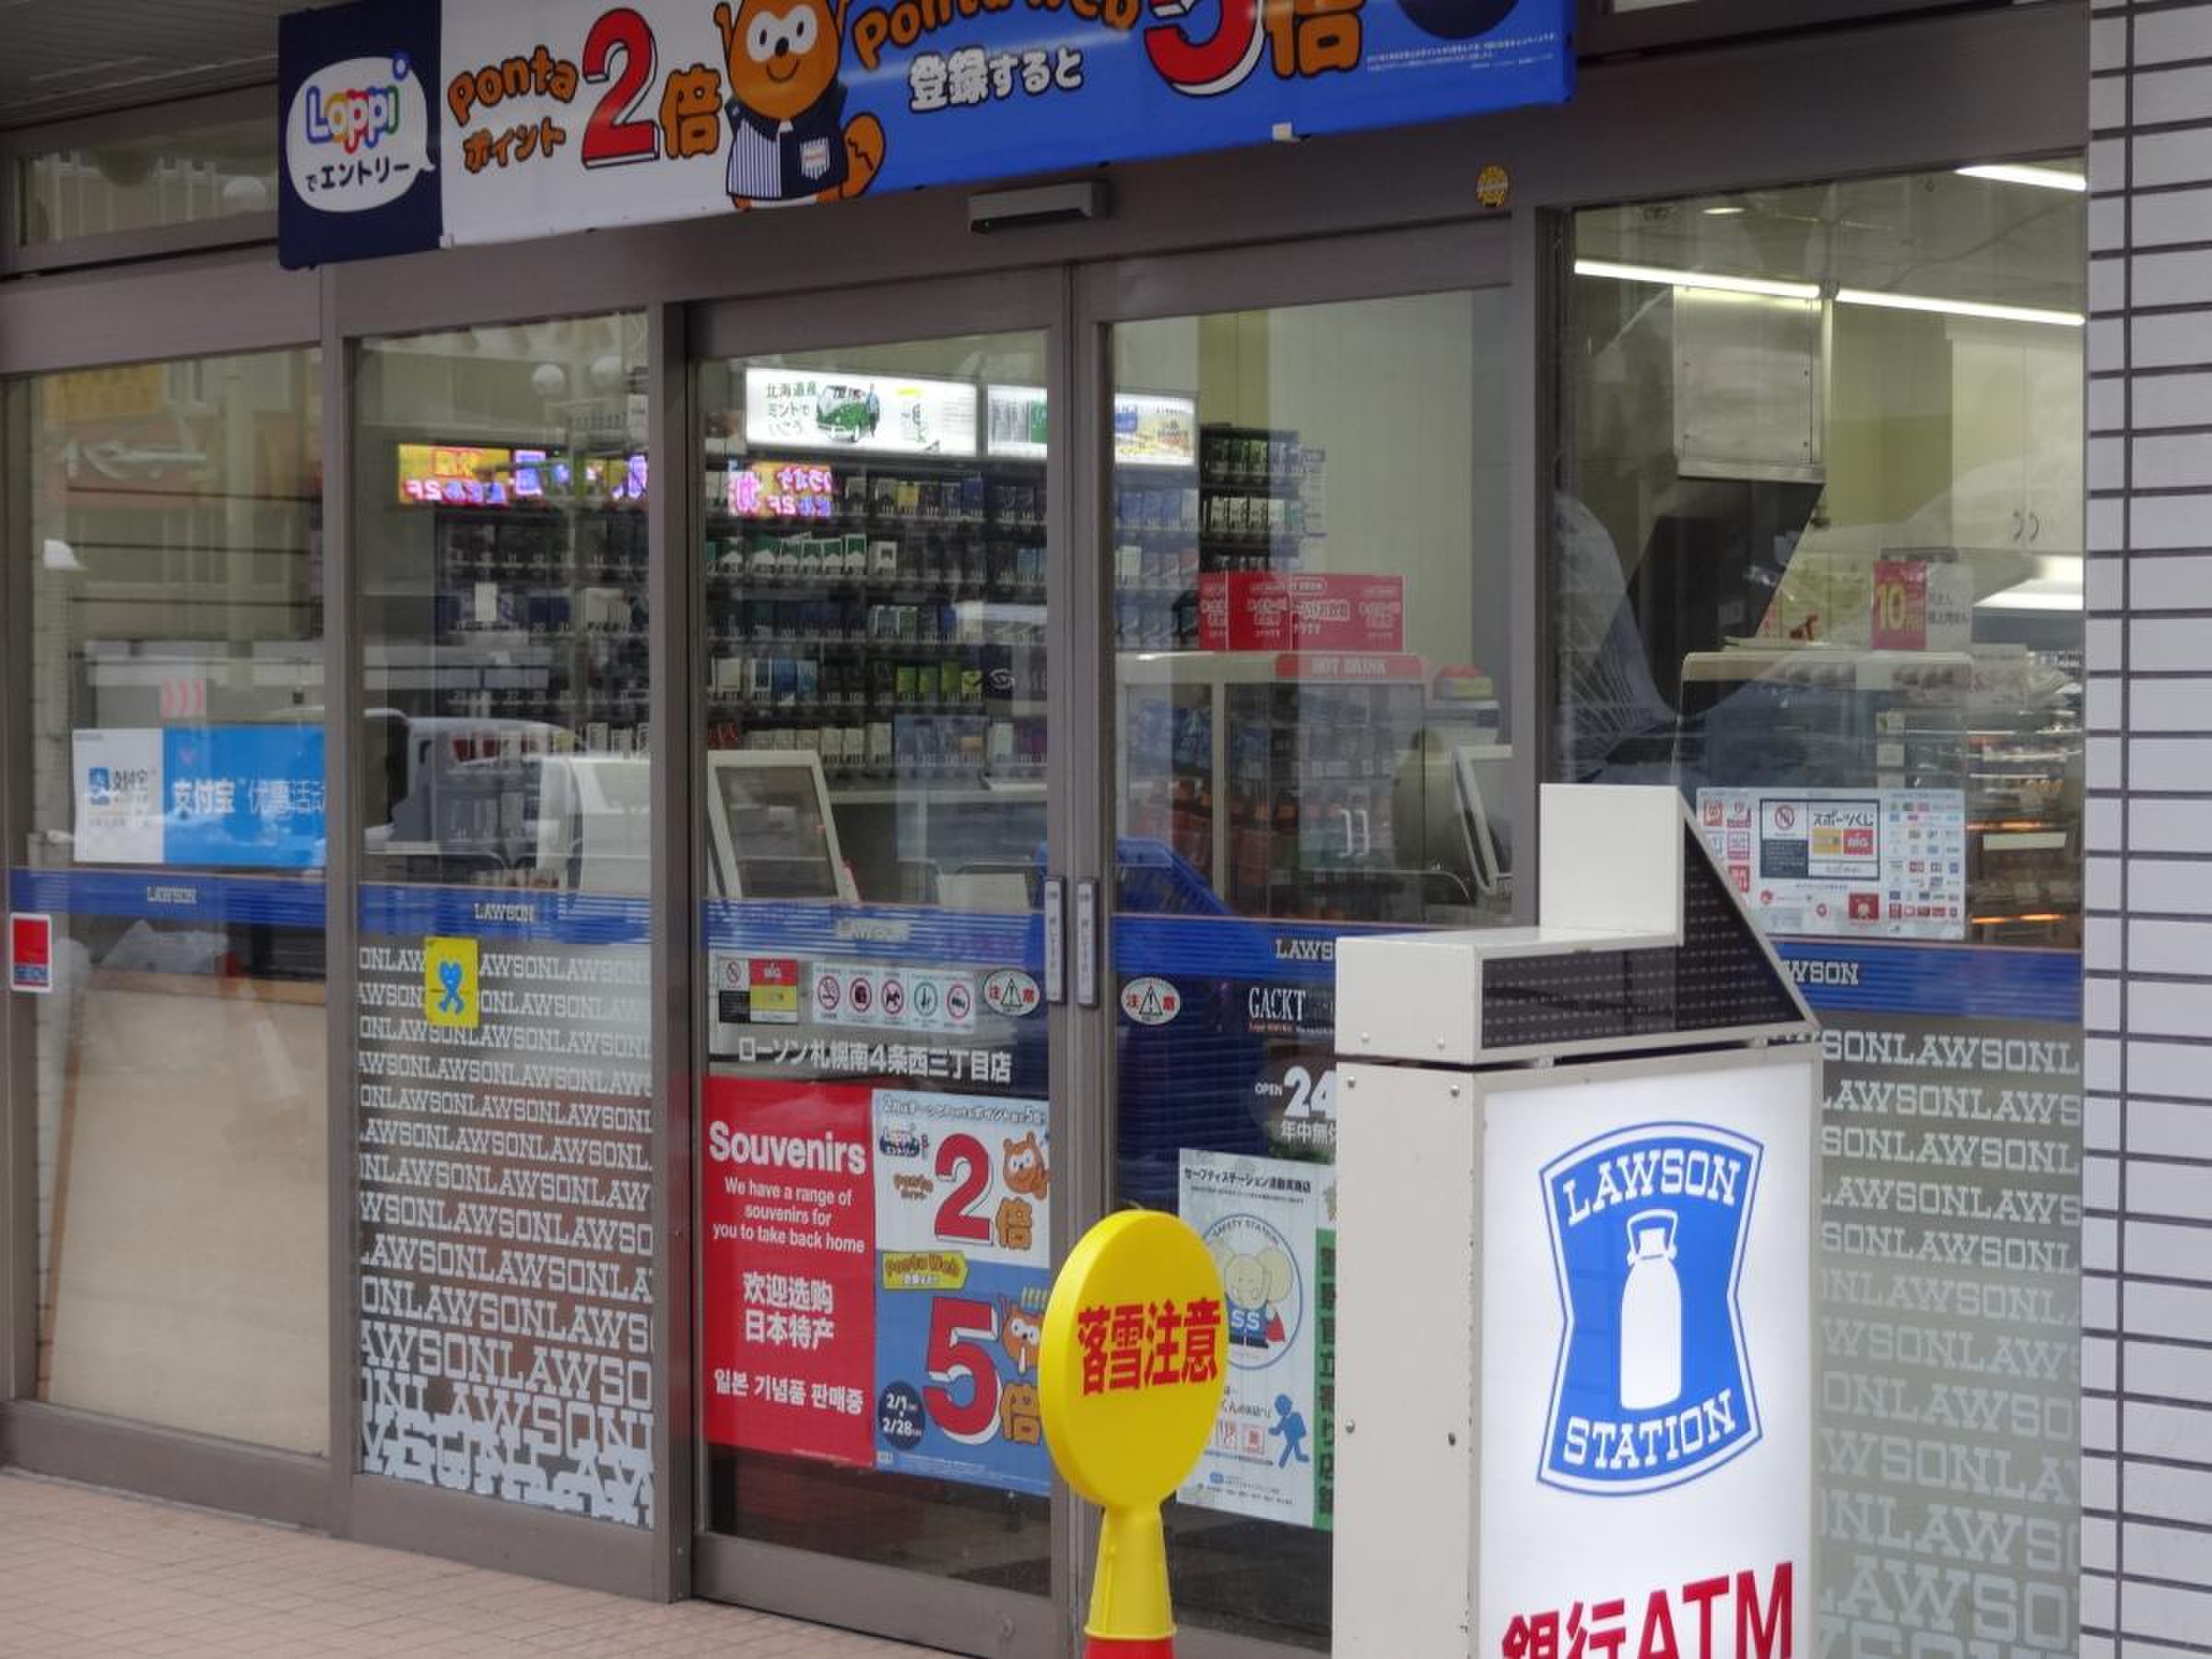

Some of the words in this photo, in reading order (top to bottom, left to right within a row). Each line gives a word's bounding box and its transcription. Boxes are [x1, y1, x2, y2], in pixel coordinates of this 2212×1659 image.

[910, 47, 1083, 112] 登録すると
[463, 116, 566, 173] ポイント
[305, 155, 411, 192] でエントリー
[174, 780, 236, 815] 支付宝
[147, 886, 197, 903] LAWSON
[474, 903, 535, 923] LAWSON
[1276, 939, 1335, 961] LAWS
[1784, 961, 1859, 985] WSON
[1248, 987, 1307, 1021] GACKT
[738, 1036, 1012, 1084] ローソン札幌南4条西三丁目店
[1254, 1083, 1284, 1096] OPEN
[1284, 1065, 1336, 1121] 24
[709, 1120, 866, 1175] Souvenirs
[724, 1176, 746, 1195] We
[749, 1180, 781, 1199] have
[784, 1186, 793, 1200] a
[796, 1187, 834, 1207] range
[838, 1189, 853, 1206] of
[1563, 1148, 1740, 1227] LAWSON
[745, 1204, 809, 1225] souvenirs
[812, 1207, 831, 1228] for
[713, 1223, 737, 1240] you
[741, 1224, 754, 1239] to
[758, 1226, 785, 1244] take
[790, 1228, 822, 1249] back
[826, 1233, 865, 1253] home
[359, 1232, 653, 1304] AWSONLAWSONLA
[743, 1270, 834, 1315] 欢迎选购
[360, 1275, 653, 1354] ONLAWSONLAWS
[745, 1309, 834, 1350] 日本特产
[1231, 1310, 1260, 1329] SS
[1077, 1298, 1221, 1395] 落雪注意
[714, 1369, 749, 1396] 일본
[755, 1373, 806, 1406] 기념품
[811, 1384, 865, 1416] 판매중
[882, 1418, 913, 1436] 2/28
[1563, 1389, 1736, 1470] STATION
[1820, 1429, 2080, 1505] WSONLA
